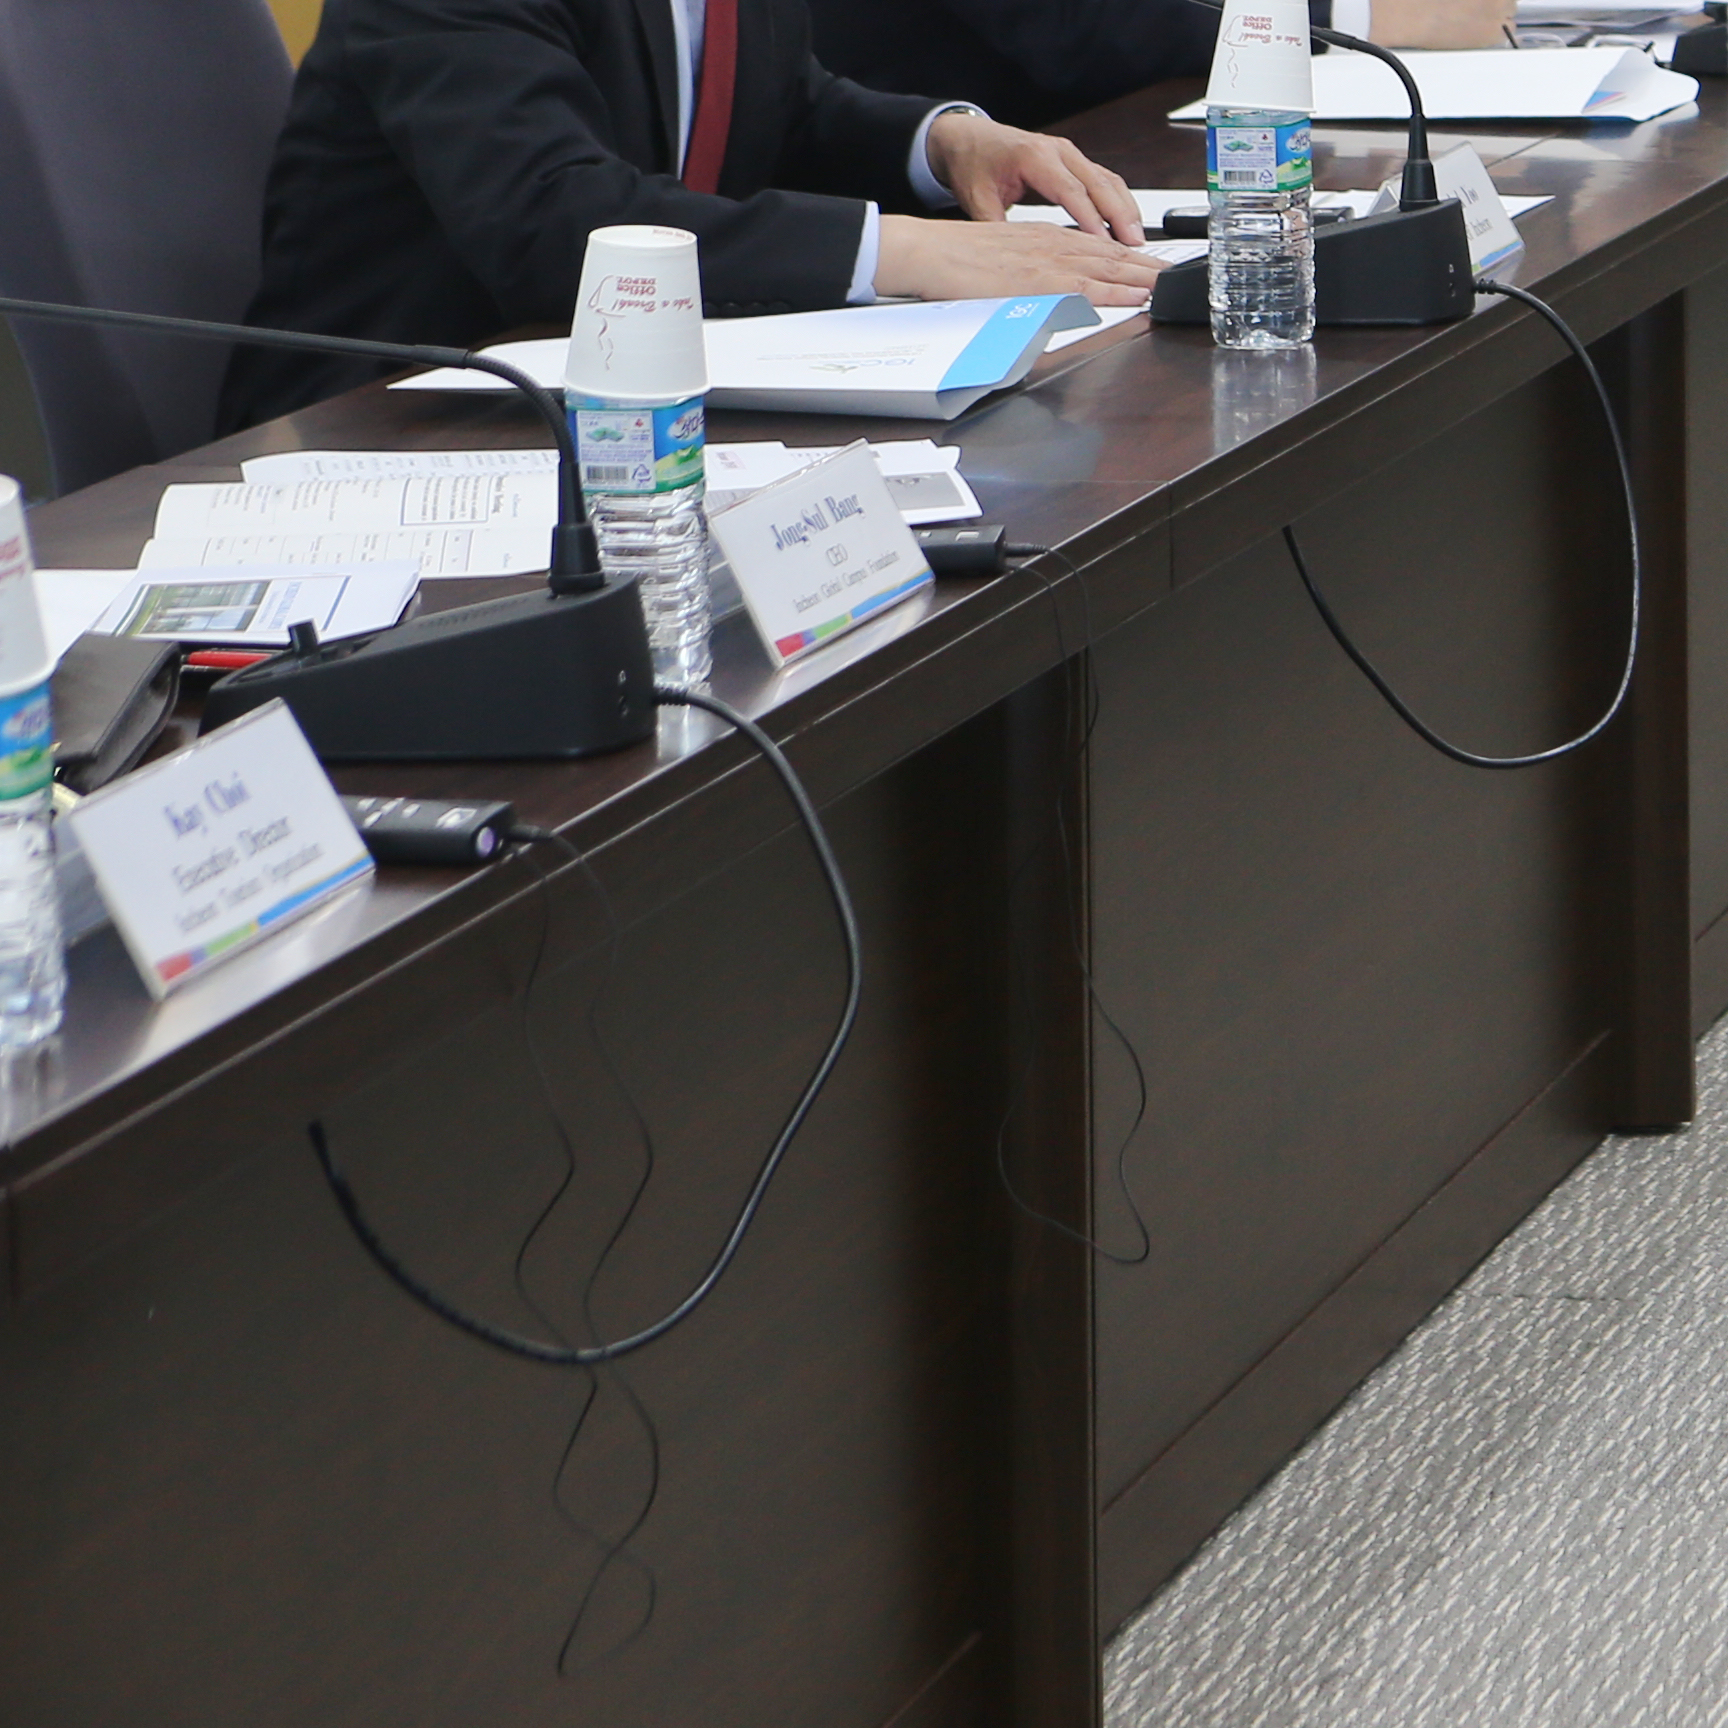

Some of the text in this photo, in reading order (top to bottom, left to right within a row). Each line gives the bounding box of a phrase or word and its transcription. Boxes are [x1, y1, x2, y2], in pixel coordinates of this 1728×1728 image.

[1243, 15, 1273, 23] DEPOT
[1242, 22, 1273, 31] Office
[616, 276, 657, 286] DEPOT
[616, 284, 657, 297] Office
[611, 297, 657, 313] Break!
[824, 493, 866, 523] Bang
[825, 542, 849, 567] CEO
